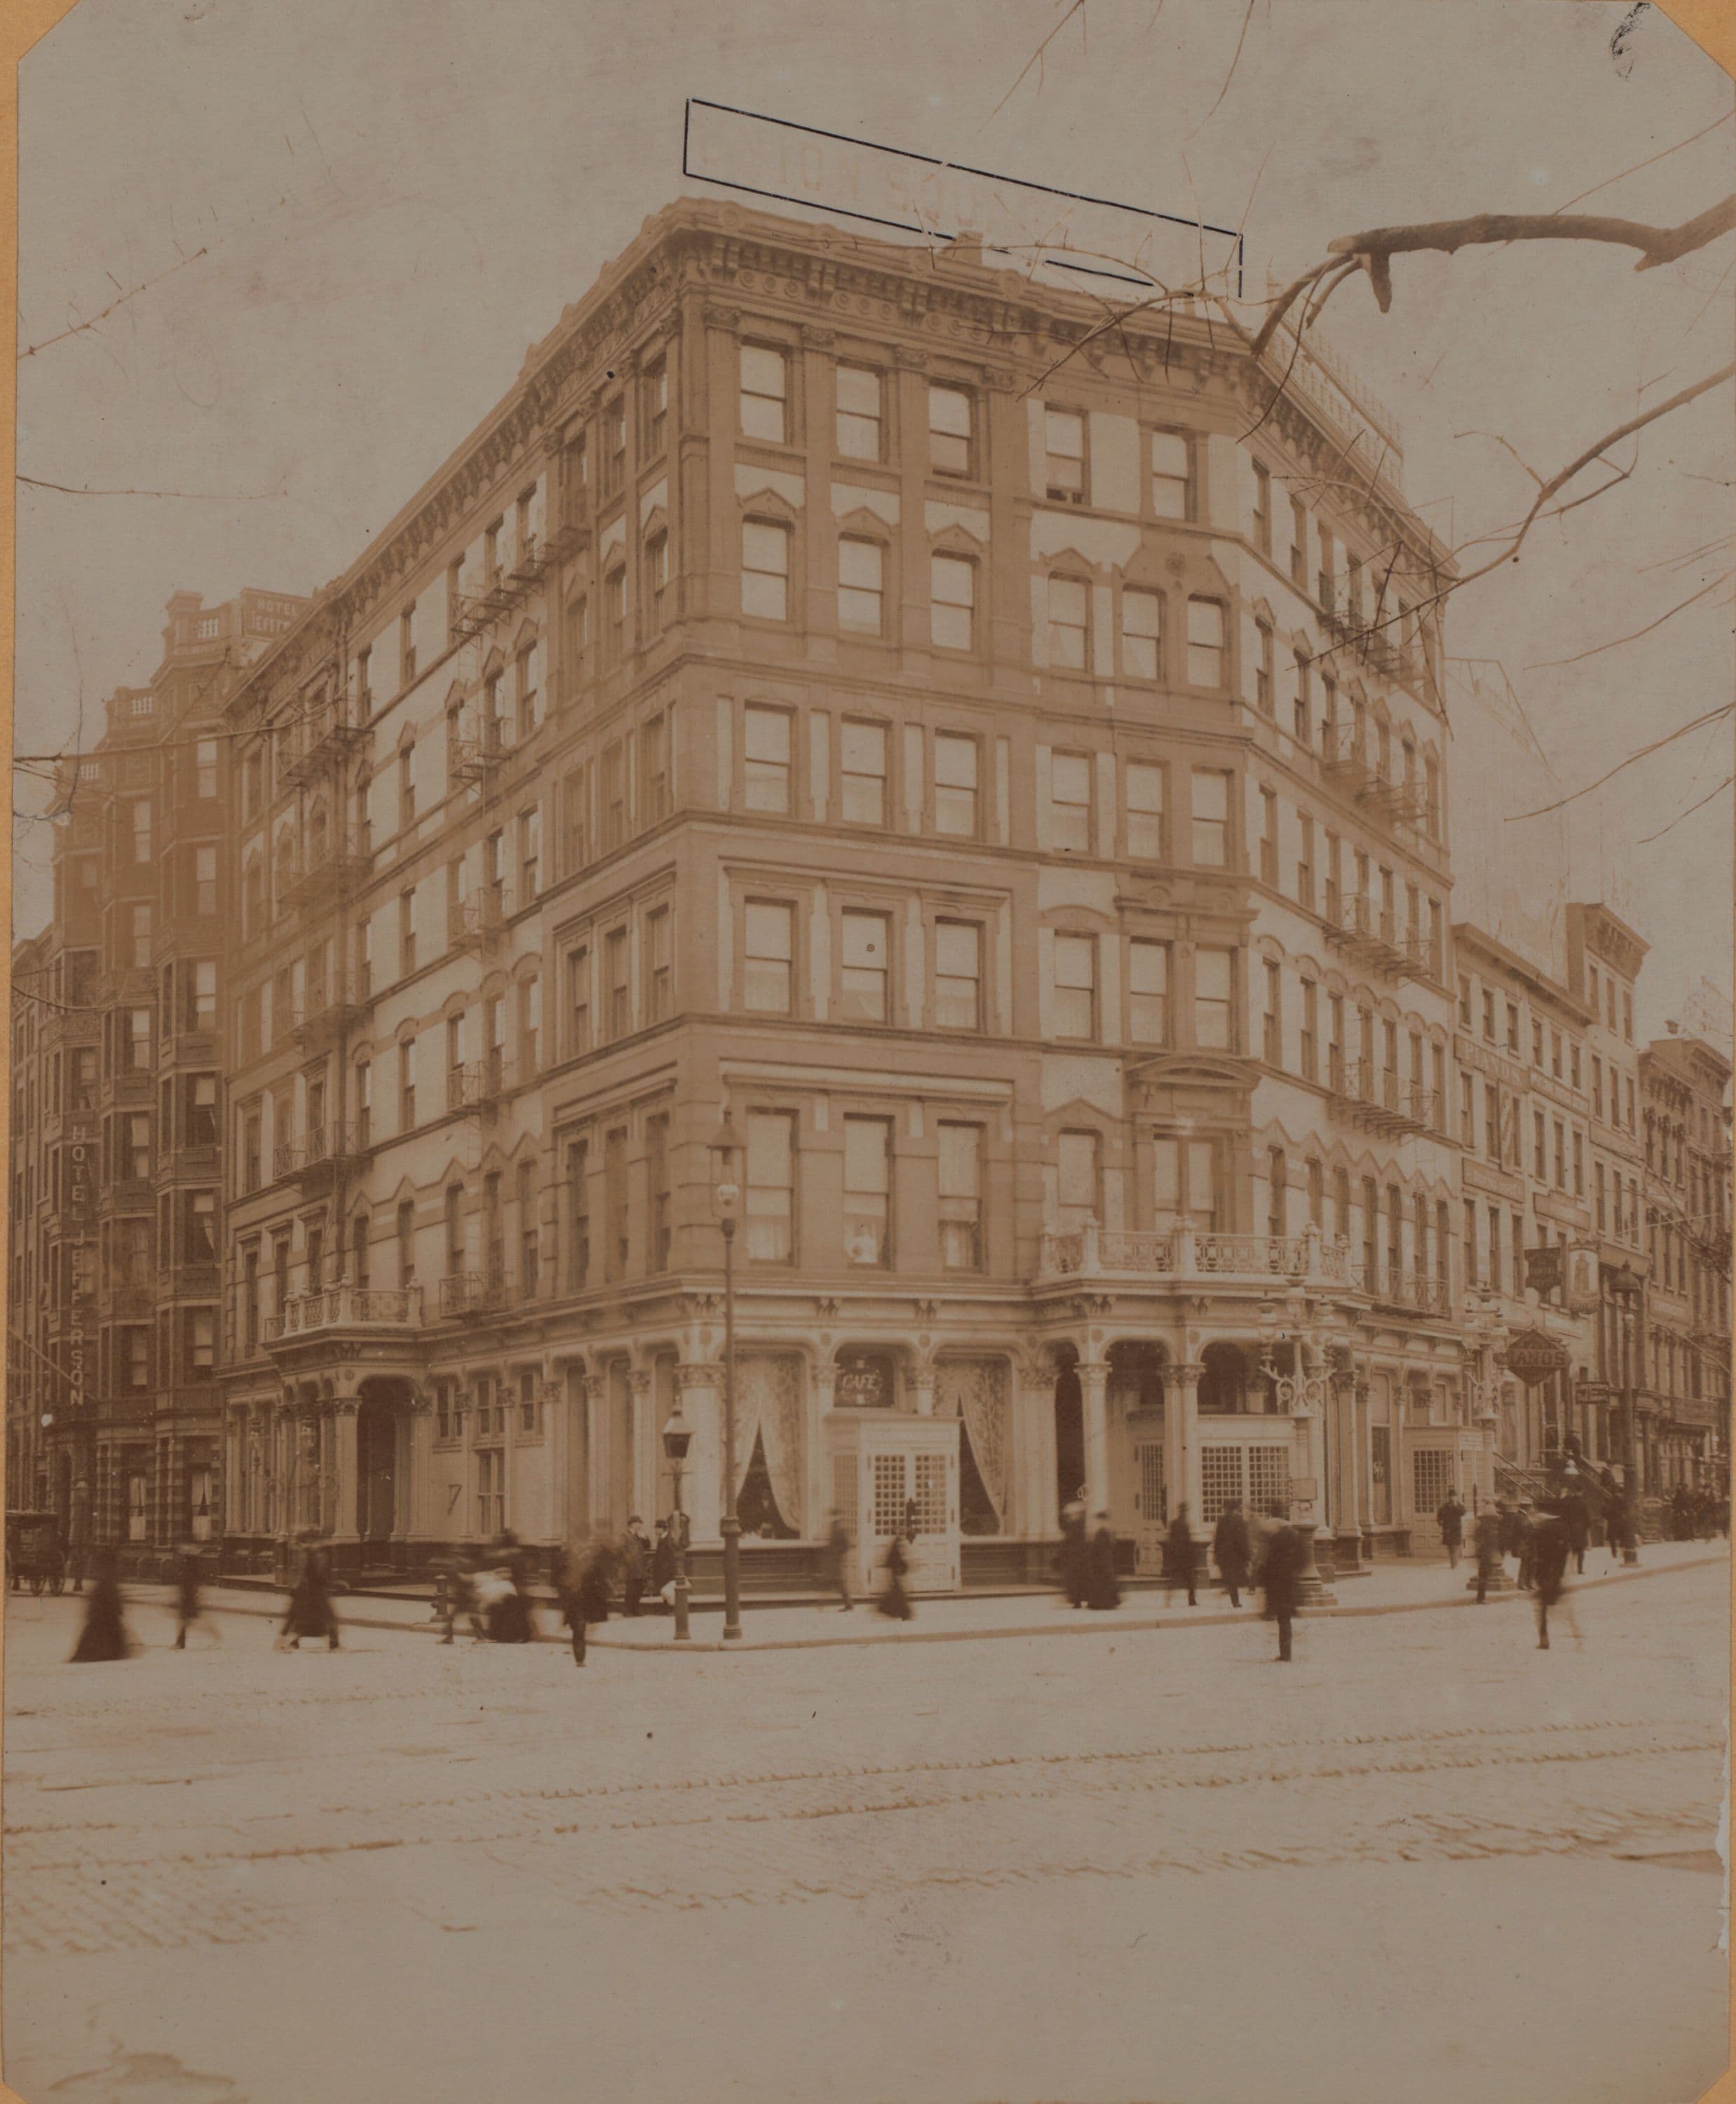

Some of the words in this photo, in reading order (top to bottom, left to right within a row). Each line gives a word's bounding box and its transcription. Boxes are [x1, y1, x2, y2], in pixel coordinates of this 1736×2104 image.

[257, 599, 297, 617] HOTEL
[1465, 1041, 1522, 1087] PIANOS
[72, 1125, 86, 1221] HOTEL
[69, 1229, 85, 1406] JEFFERSON
[1499, 1350, 1566, 1366] IANOS
